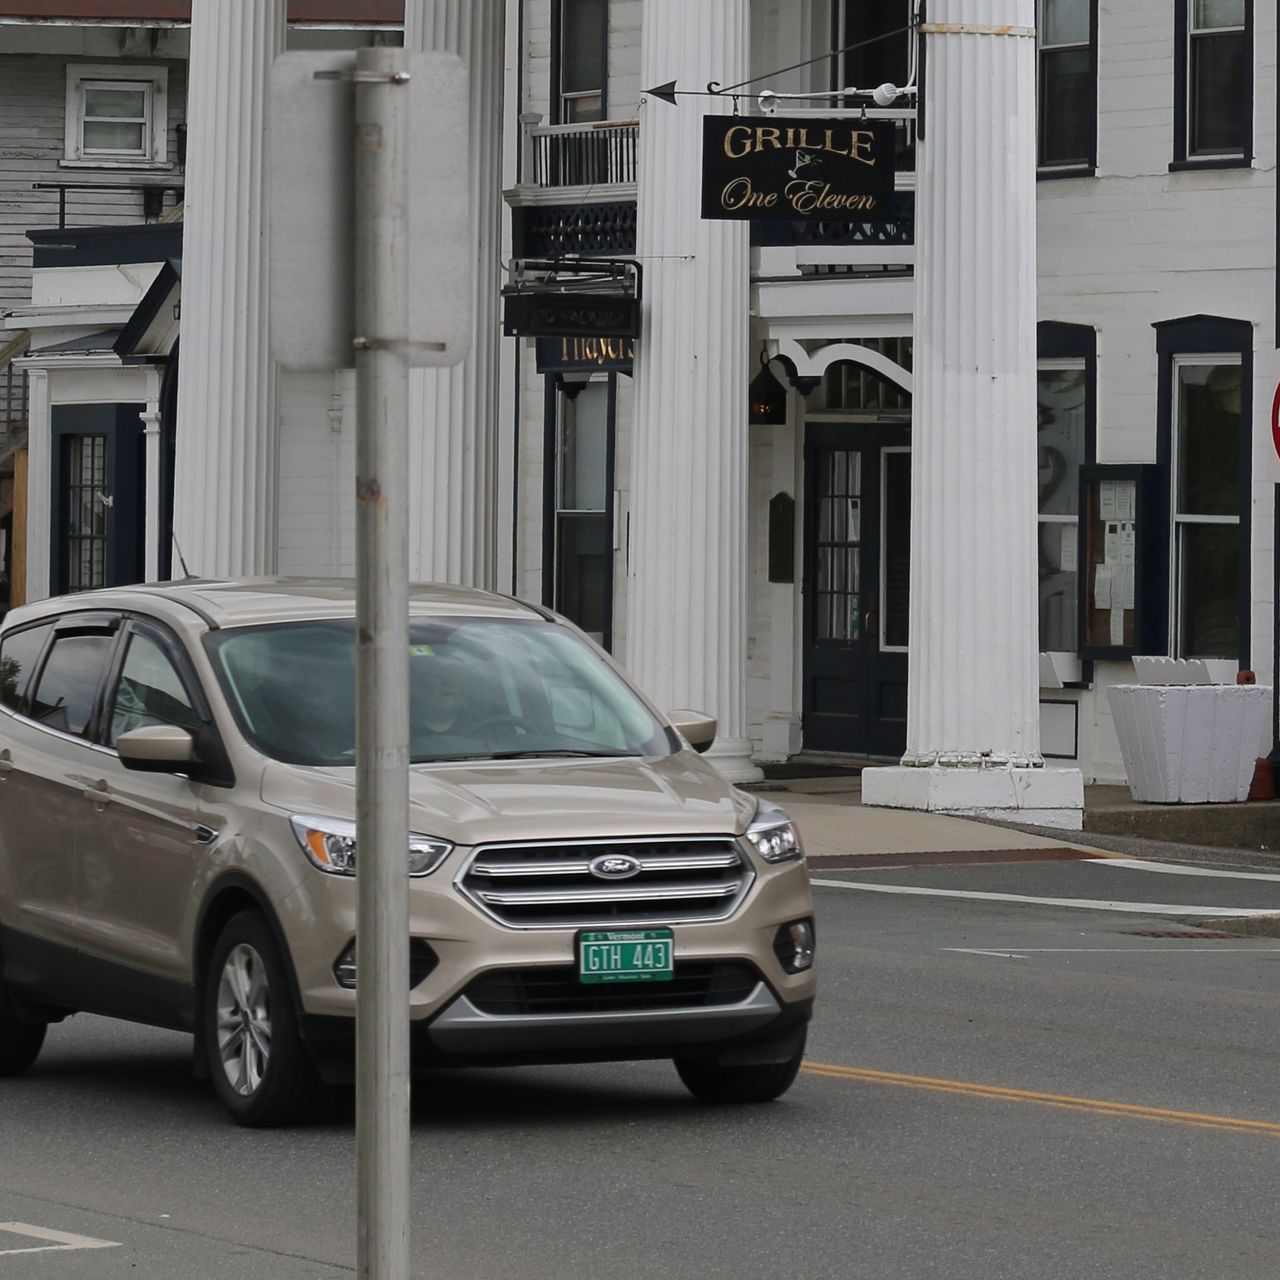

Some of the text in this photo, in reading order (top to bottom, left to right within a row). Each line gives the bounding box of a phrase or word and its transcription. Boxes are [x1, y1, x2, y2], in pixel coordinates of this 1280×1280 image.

[724, 125, 876, 167] GRILLE
[721, 176, 877, 215] One Eleven
[588, 943, 666, 971] GTH 443
